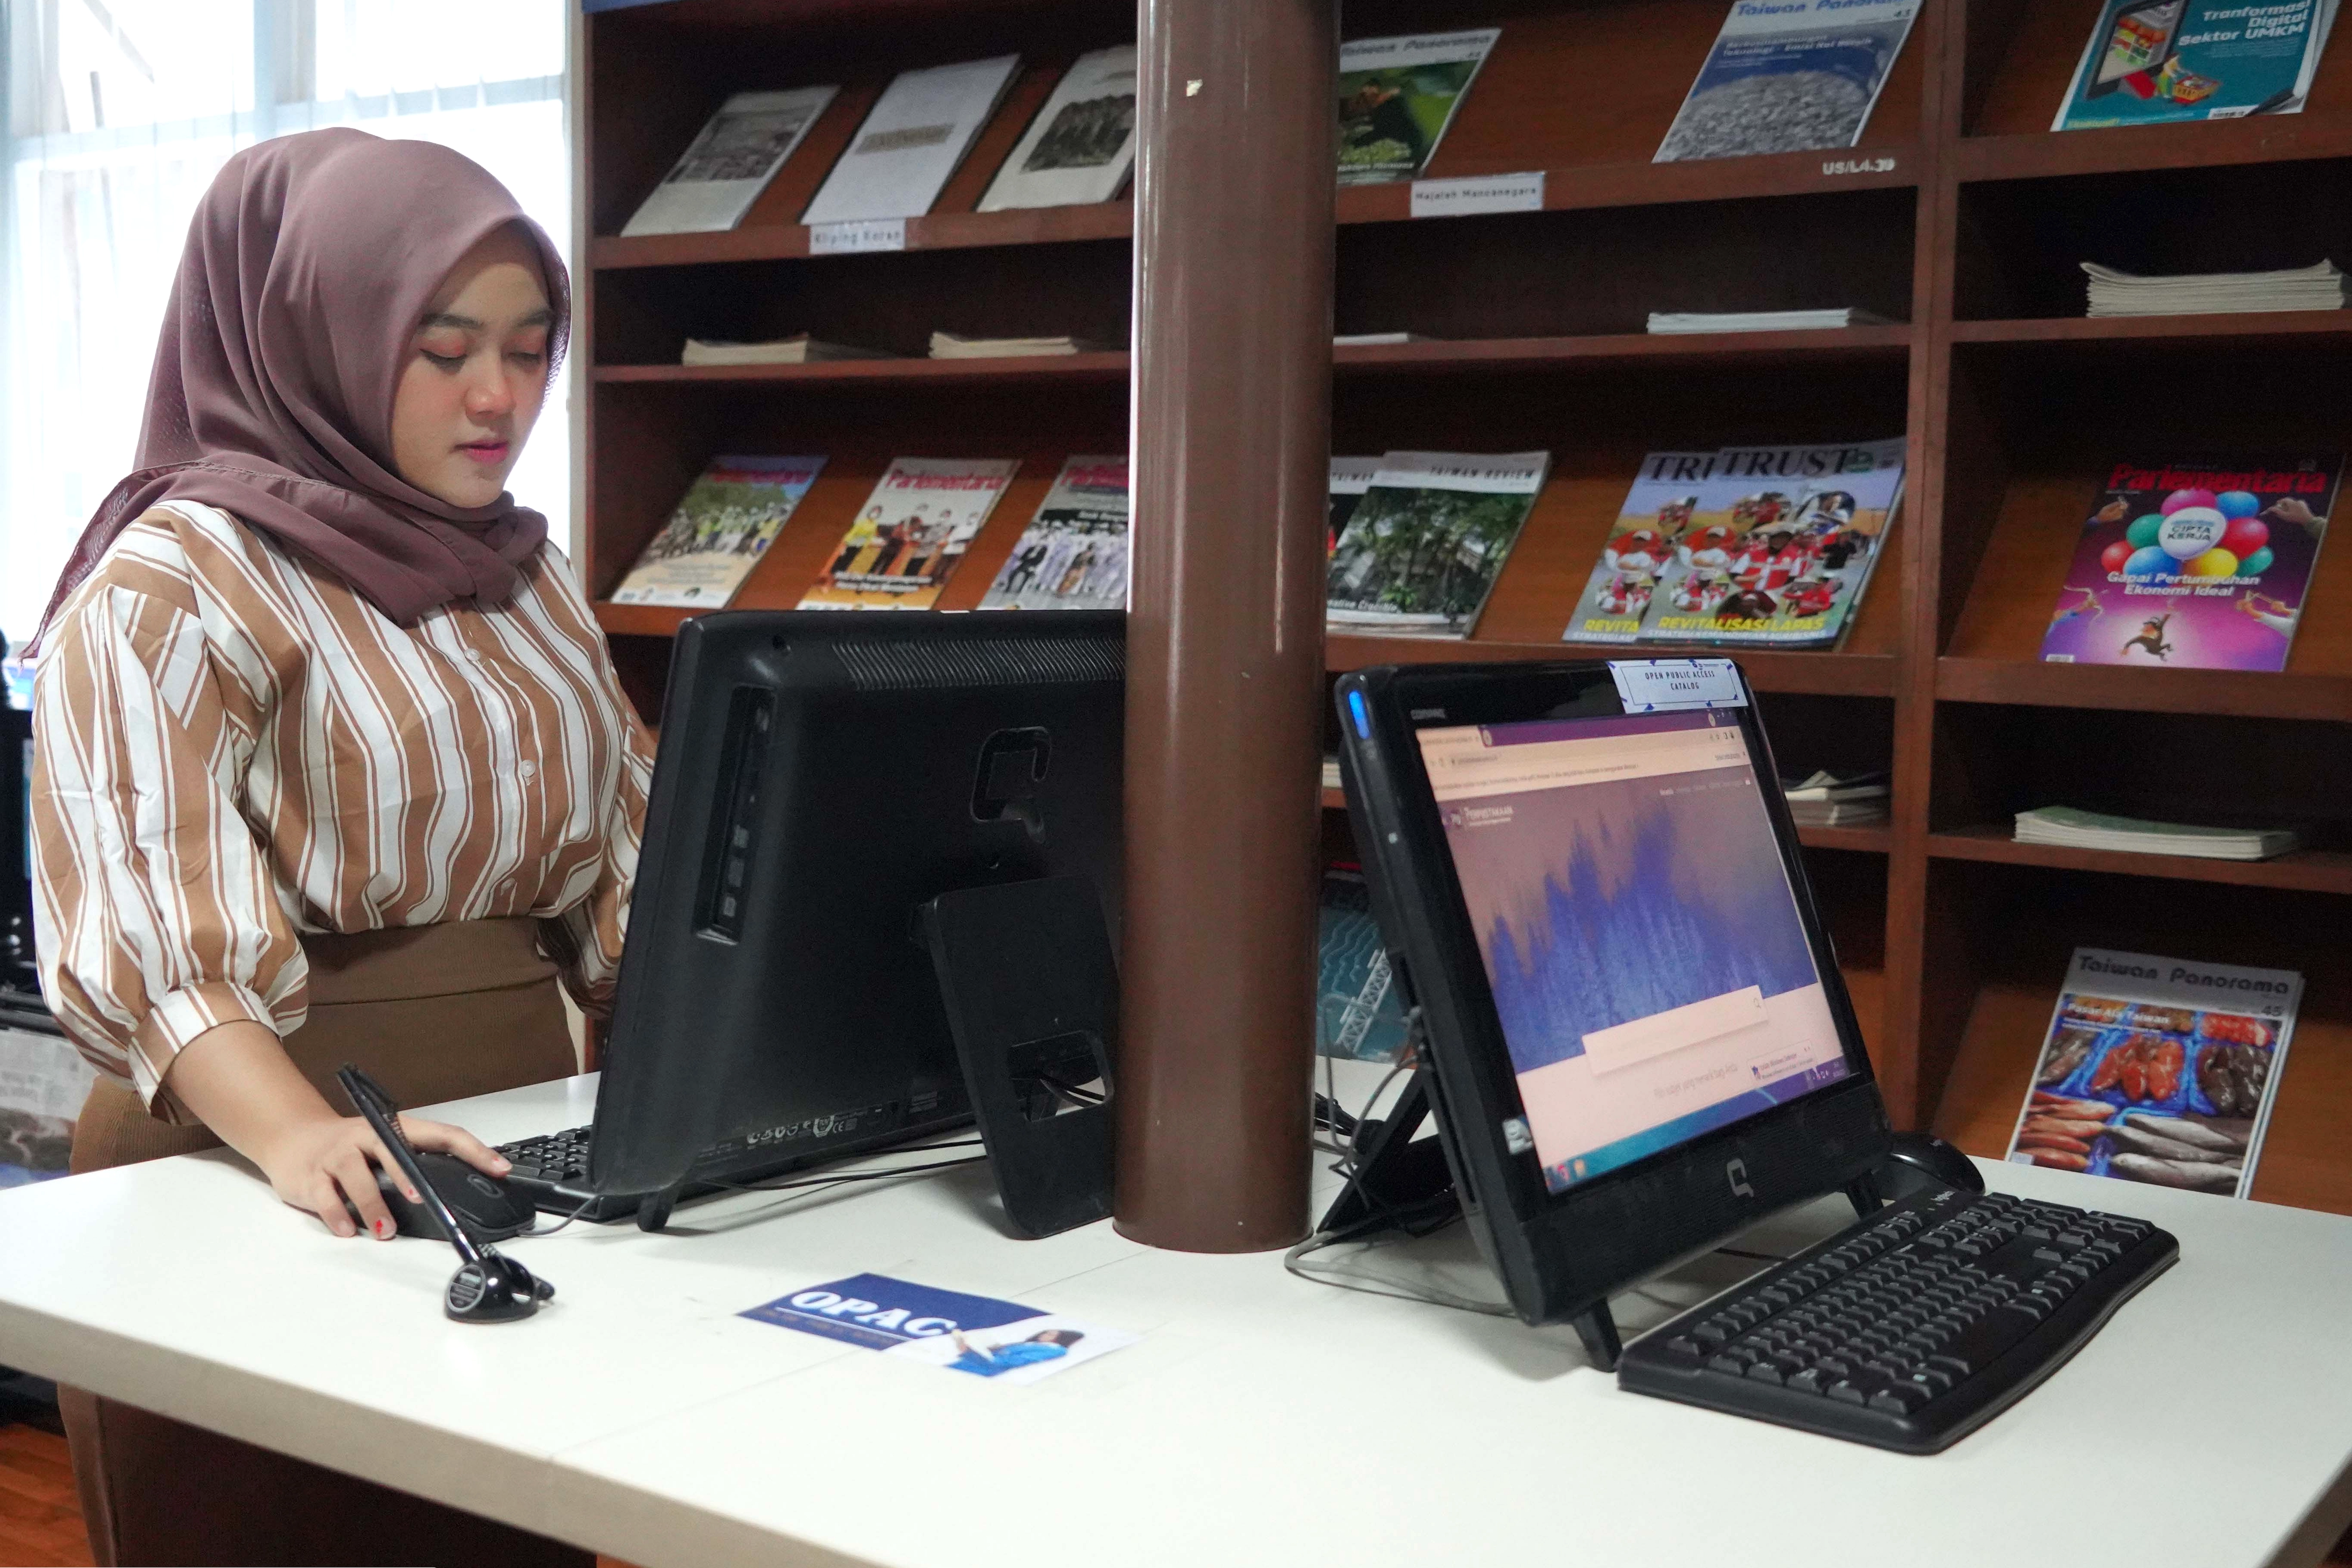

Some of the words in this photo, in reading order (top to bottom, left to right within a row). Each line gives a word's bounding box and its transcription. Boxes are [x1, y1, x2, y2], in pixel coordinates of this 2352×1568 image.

[1737, 3, 1806, 16] Taiwan
[2248, 9, 2308, 28] Digital
[2178, 31, 2239, 46] Sektor
[2245, 22, 2305, 39] UMKM
[1726, 449, 1859, 477] TRUST
[2106, 464, 2328, 494] Parlementaria
[2167, 532, 2211, 541] KERJA
[2107, 571, 2151, 583] Gapai
[2154, 573, 2261, 585] Pertumbuhan
[2124, 584, 2190, 595] Ekonomi
[2194, 586, 2235, 596] Ideal
[1658, 617, 1768, 630] REVITALISASI
[1645, 672, 1664, 680] OPEN
[1666, 671, 1691, 679] PUBLIC
[1670, 682, 1700, 691] CATALOG
[2079, 955, 2158, 980] Taiwan
[2170, 967, 2289, 994] Panorama
[791, 1291, 958, 1336] OPAC
